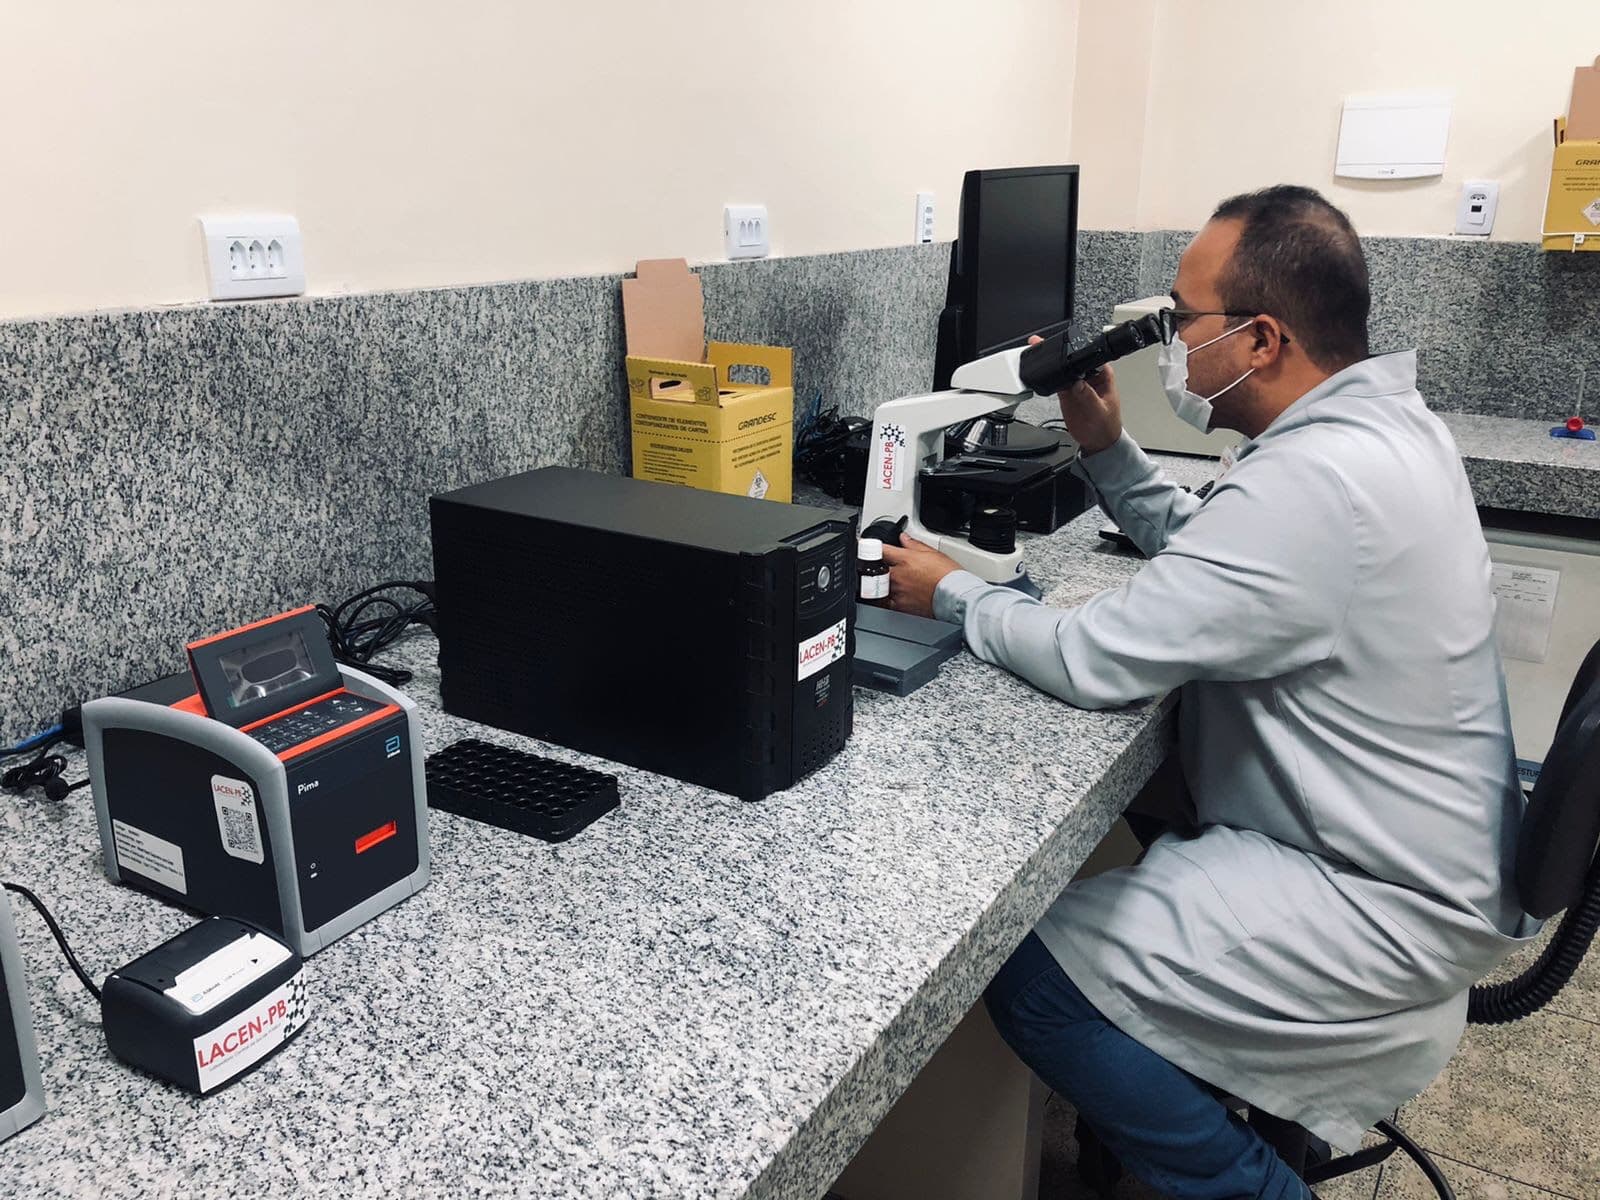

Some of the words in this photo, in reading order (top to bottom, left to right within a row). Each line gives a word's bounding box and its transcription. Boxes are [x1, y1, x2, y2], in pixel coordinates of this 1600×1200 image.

[738, 412, 777, 431] GRANDESC
[882, 441, 894, 489] LACEN-PB
[799, 634, 836, 664] LACEN-PB
[297, 780, 319, 795] Pima
[198, 999, 287, 1068] LACEN-PB
